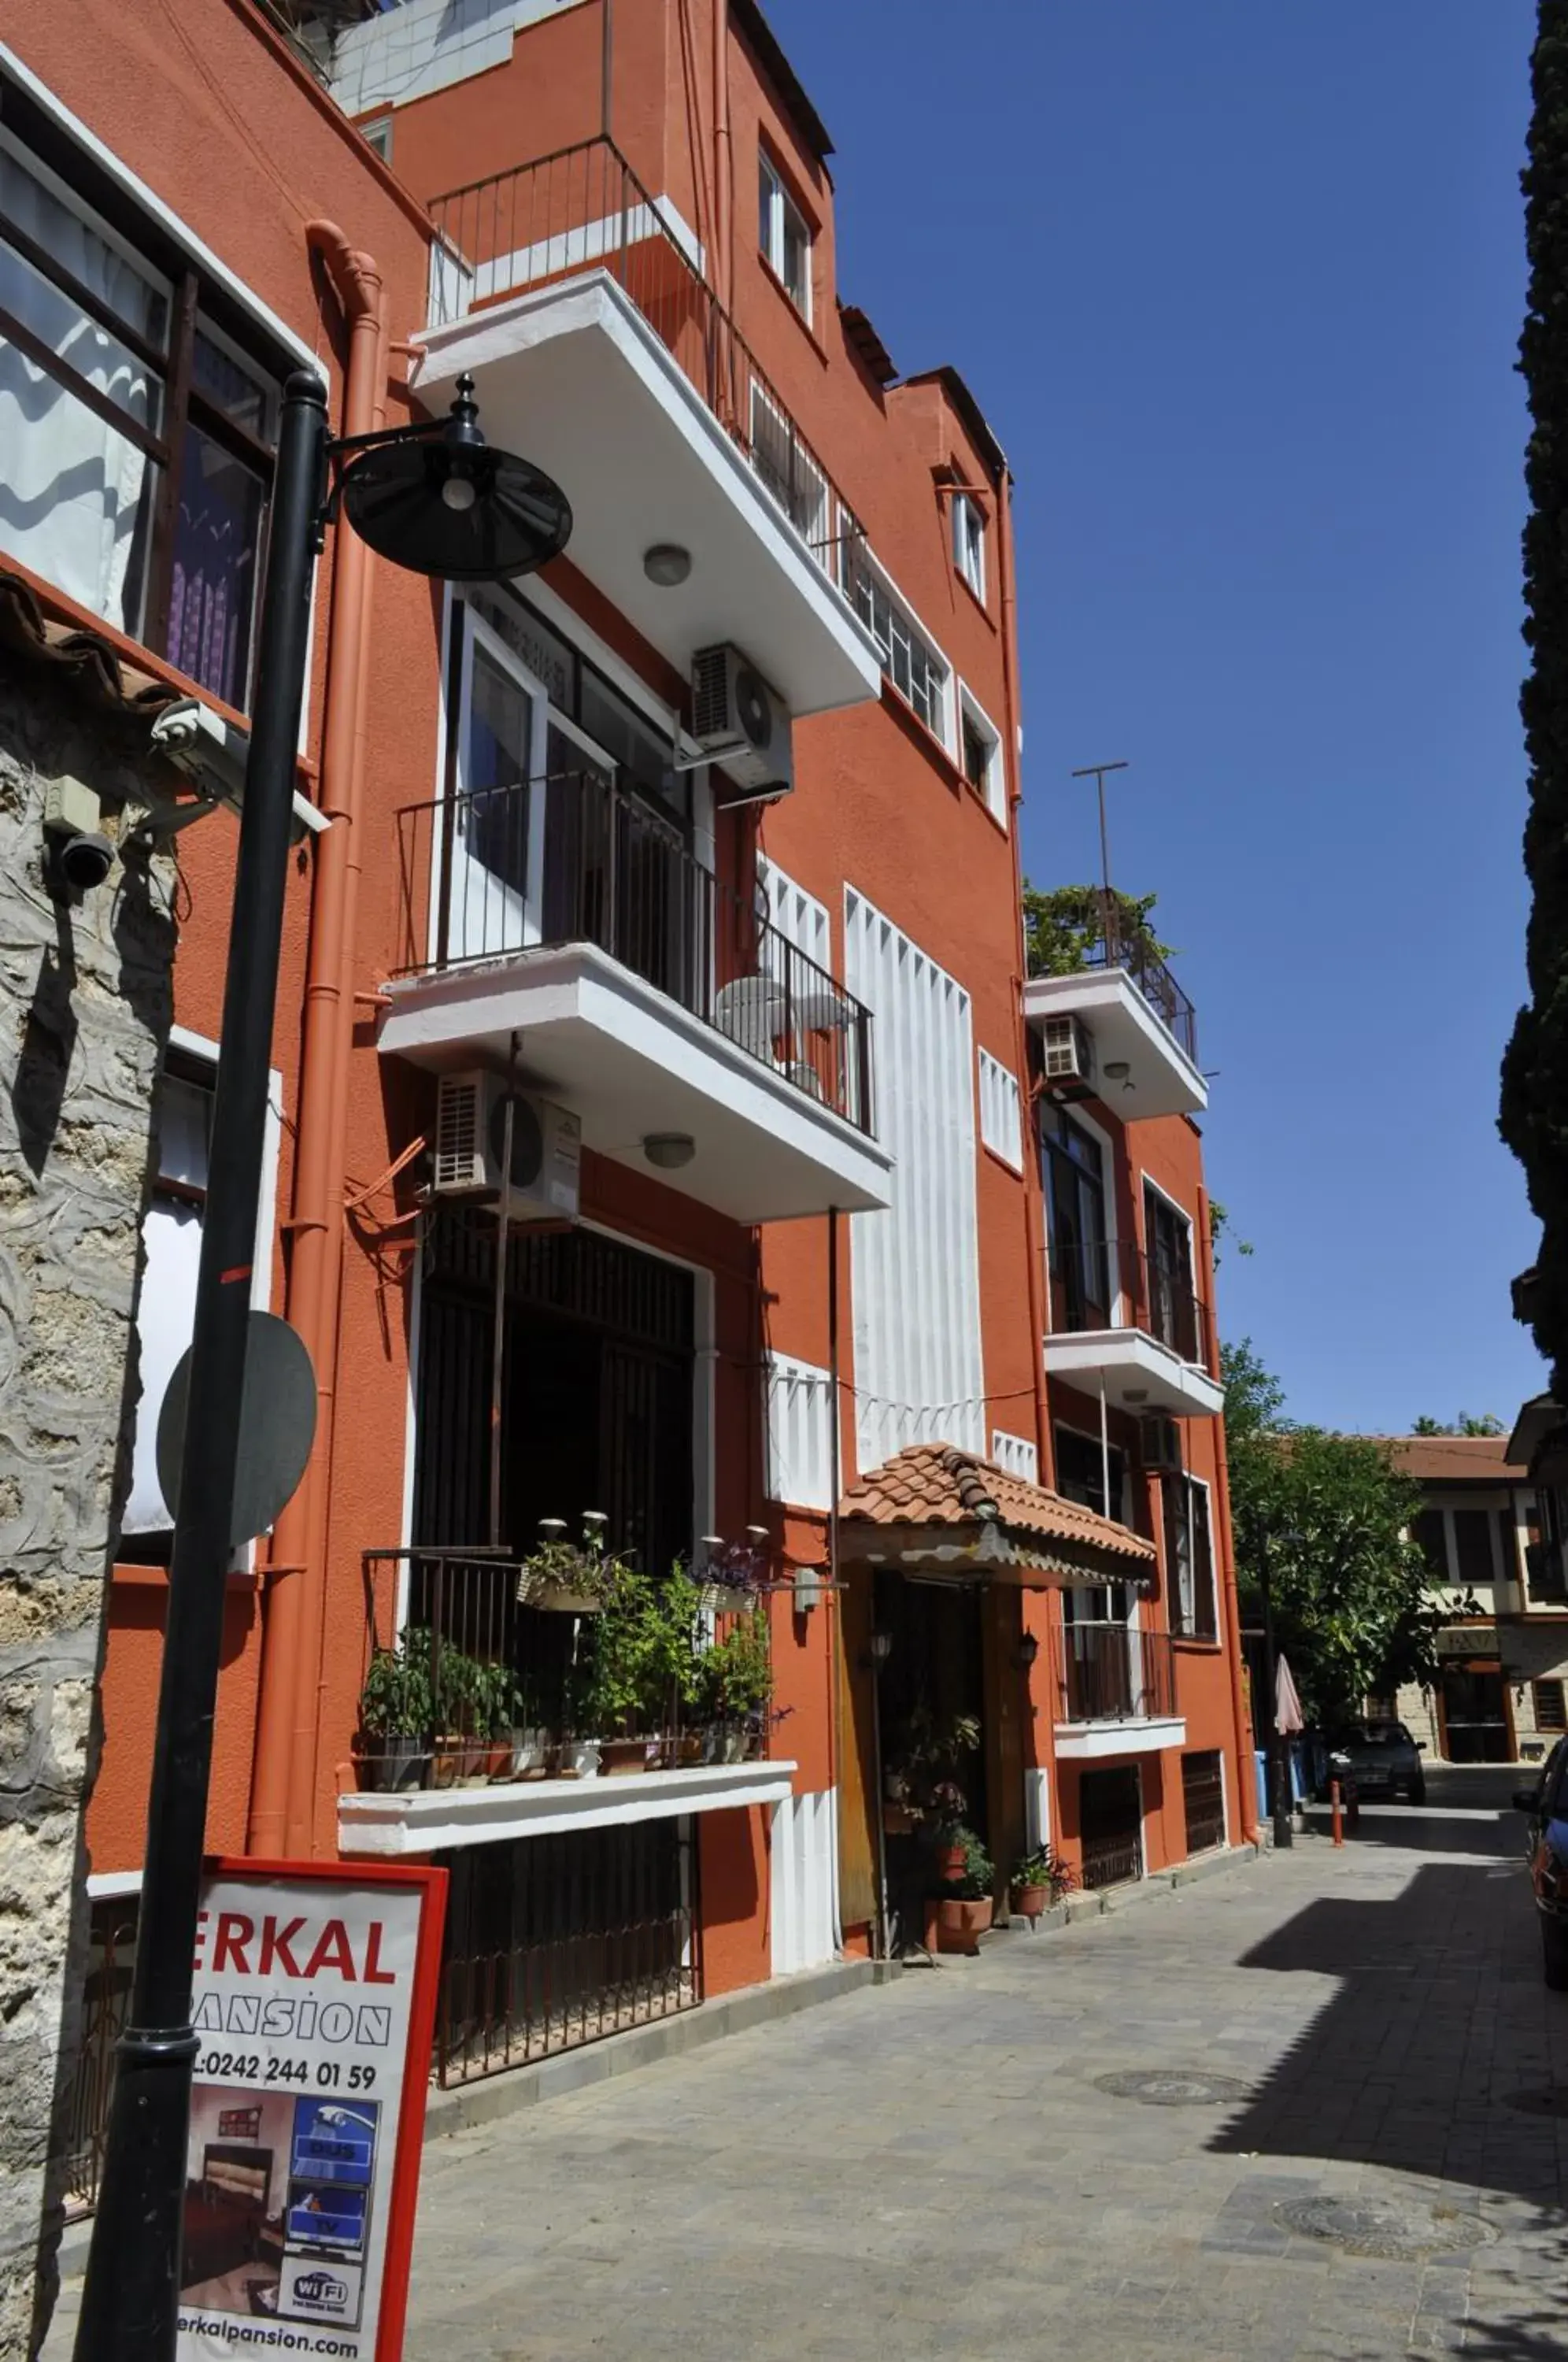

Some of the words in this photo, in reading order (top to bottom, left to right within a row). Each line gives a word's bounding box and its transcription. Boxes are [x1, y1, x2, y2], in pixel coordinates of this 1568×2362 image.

[190, 1991, 391, 2046] ANSİON
[264, 2057, 308, 2084] 244
[316, 2061, 340, 2087] 01
[347, 2064, 376, 2090] 59
[315, 2218, 339, 2234] TV
